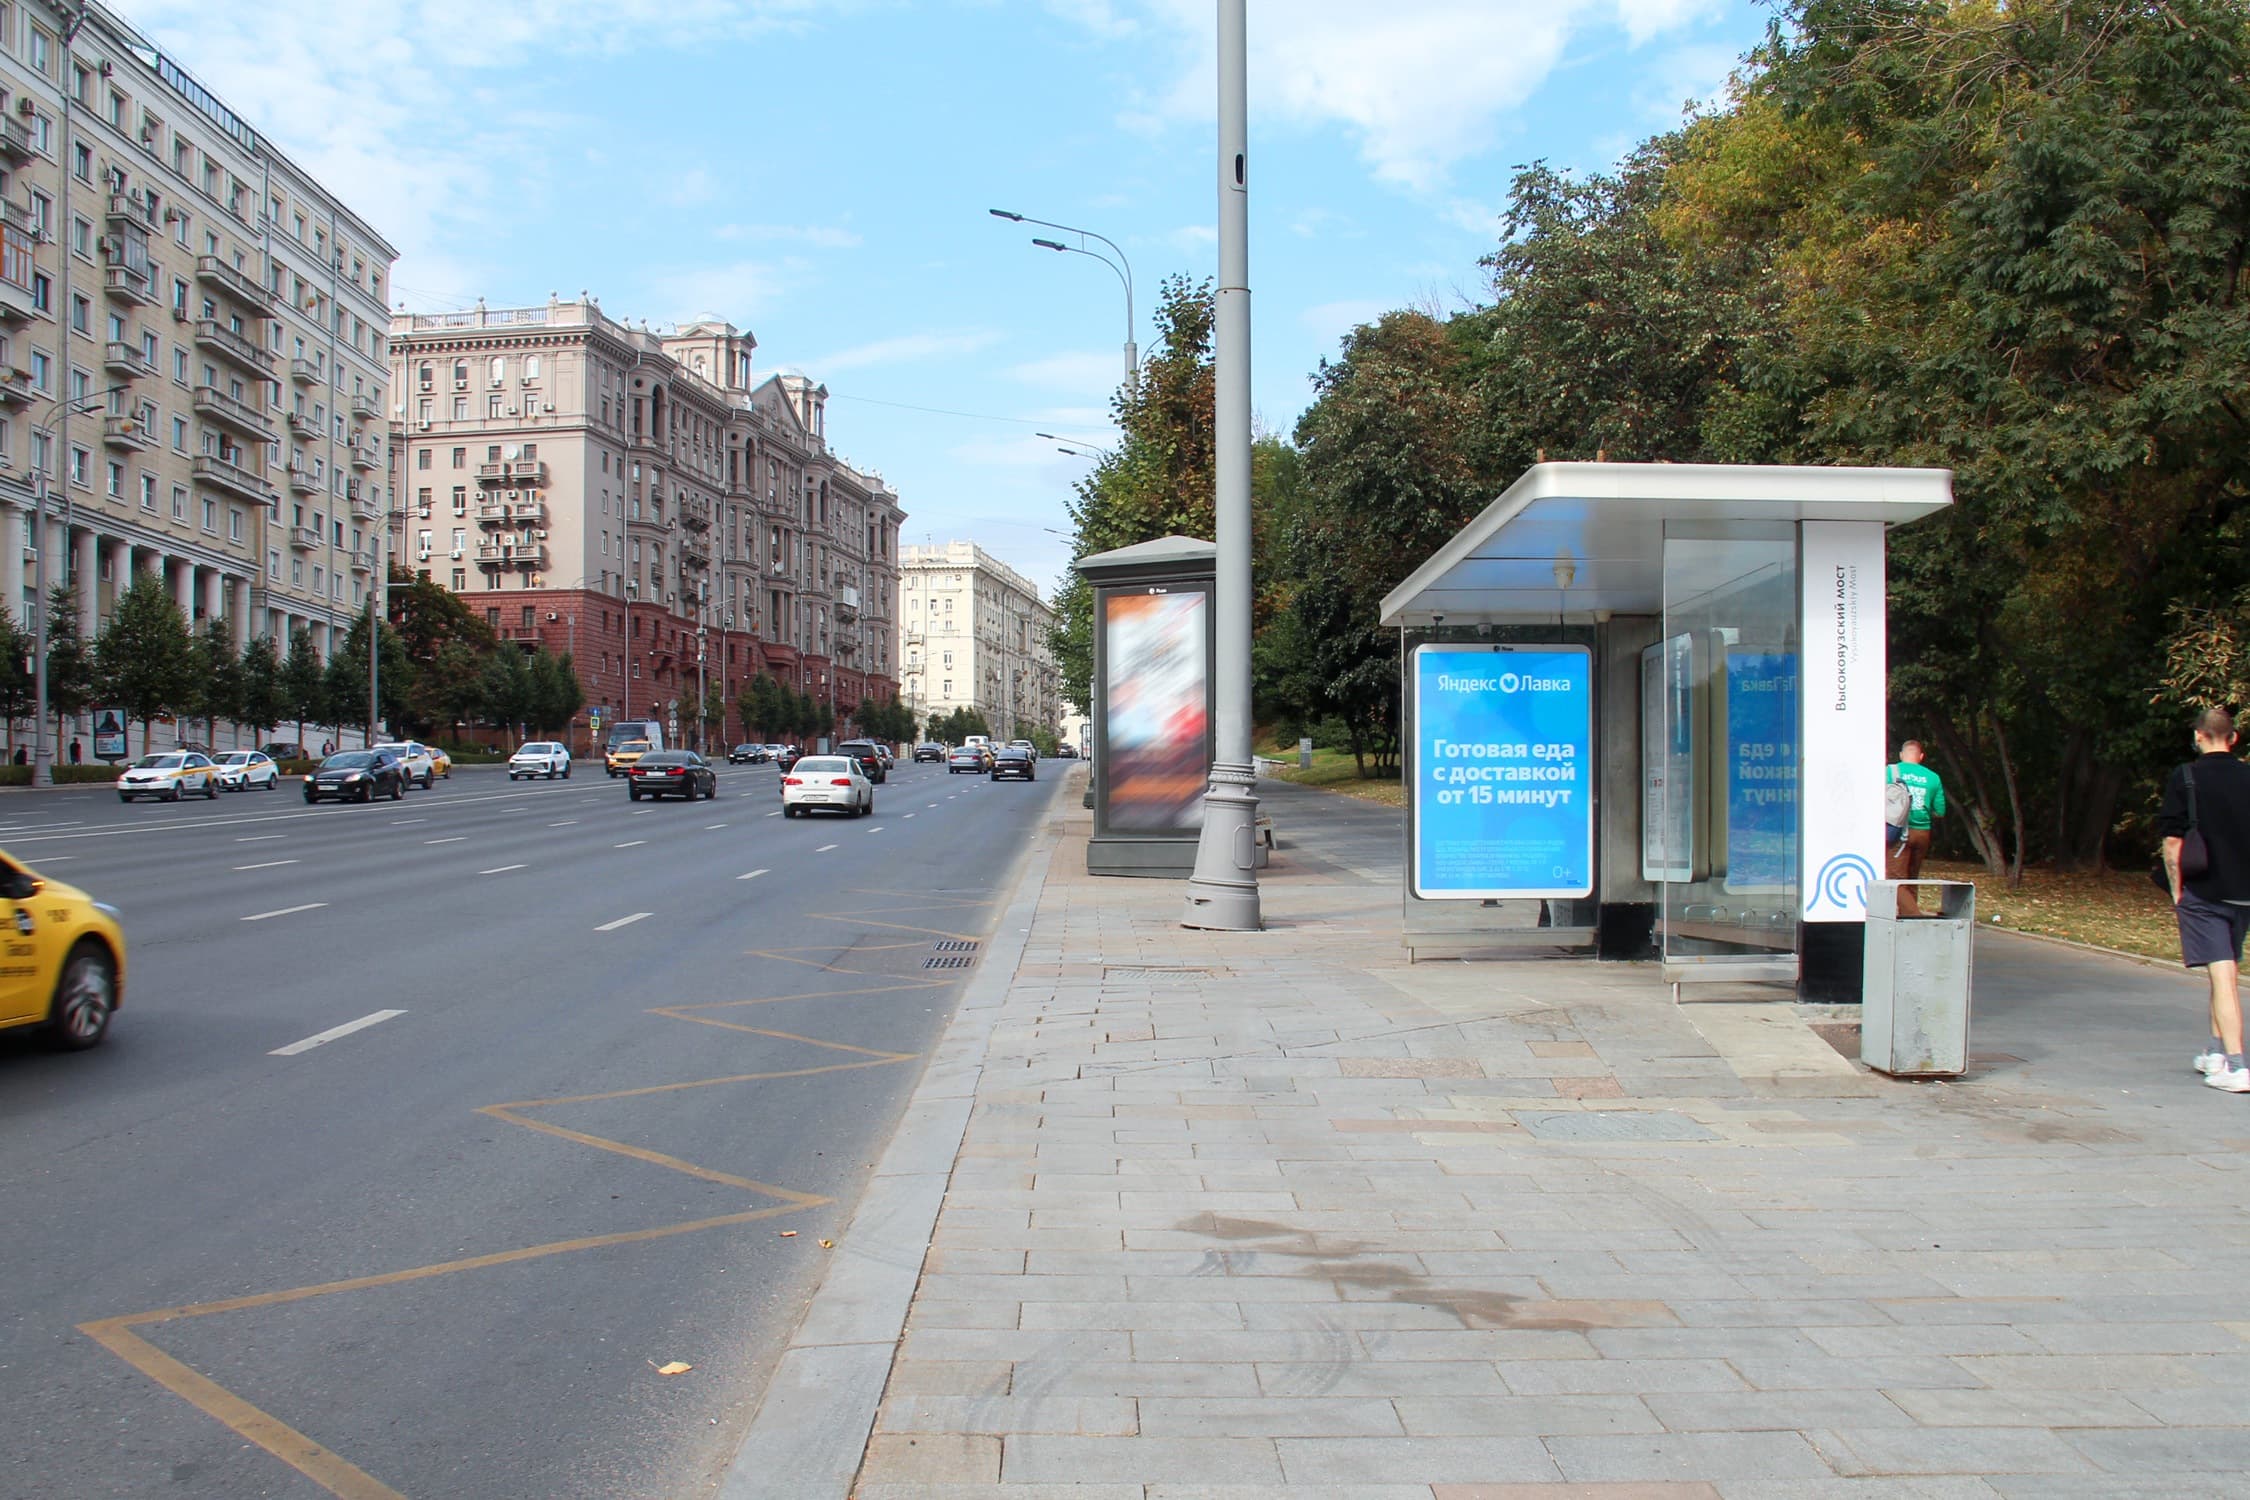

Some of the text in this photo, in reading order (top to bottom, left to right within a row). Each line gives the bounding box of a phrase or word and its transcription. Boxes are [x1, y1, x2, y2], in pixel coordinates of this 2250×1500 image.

[1834, 565, 1848, 711] Высокояузский мост
[1438, 675, 1571, 692] Яндекс Лавка
[1433, 739, 1575, 761] Готовая еда
[1433, 761, 1576, 784] с доставкой
[1437, 785, 1572, 808] от 15 минут
